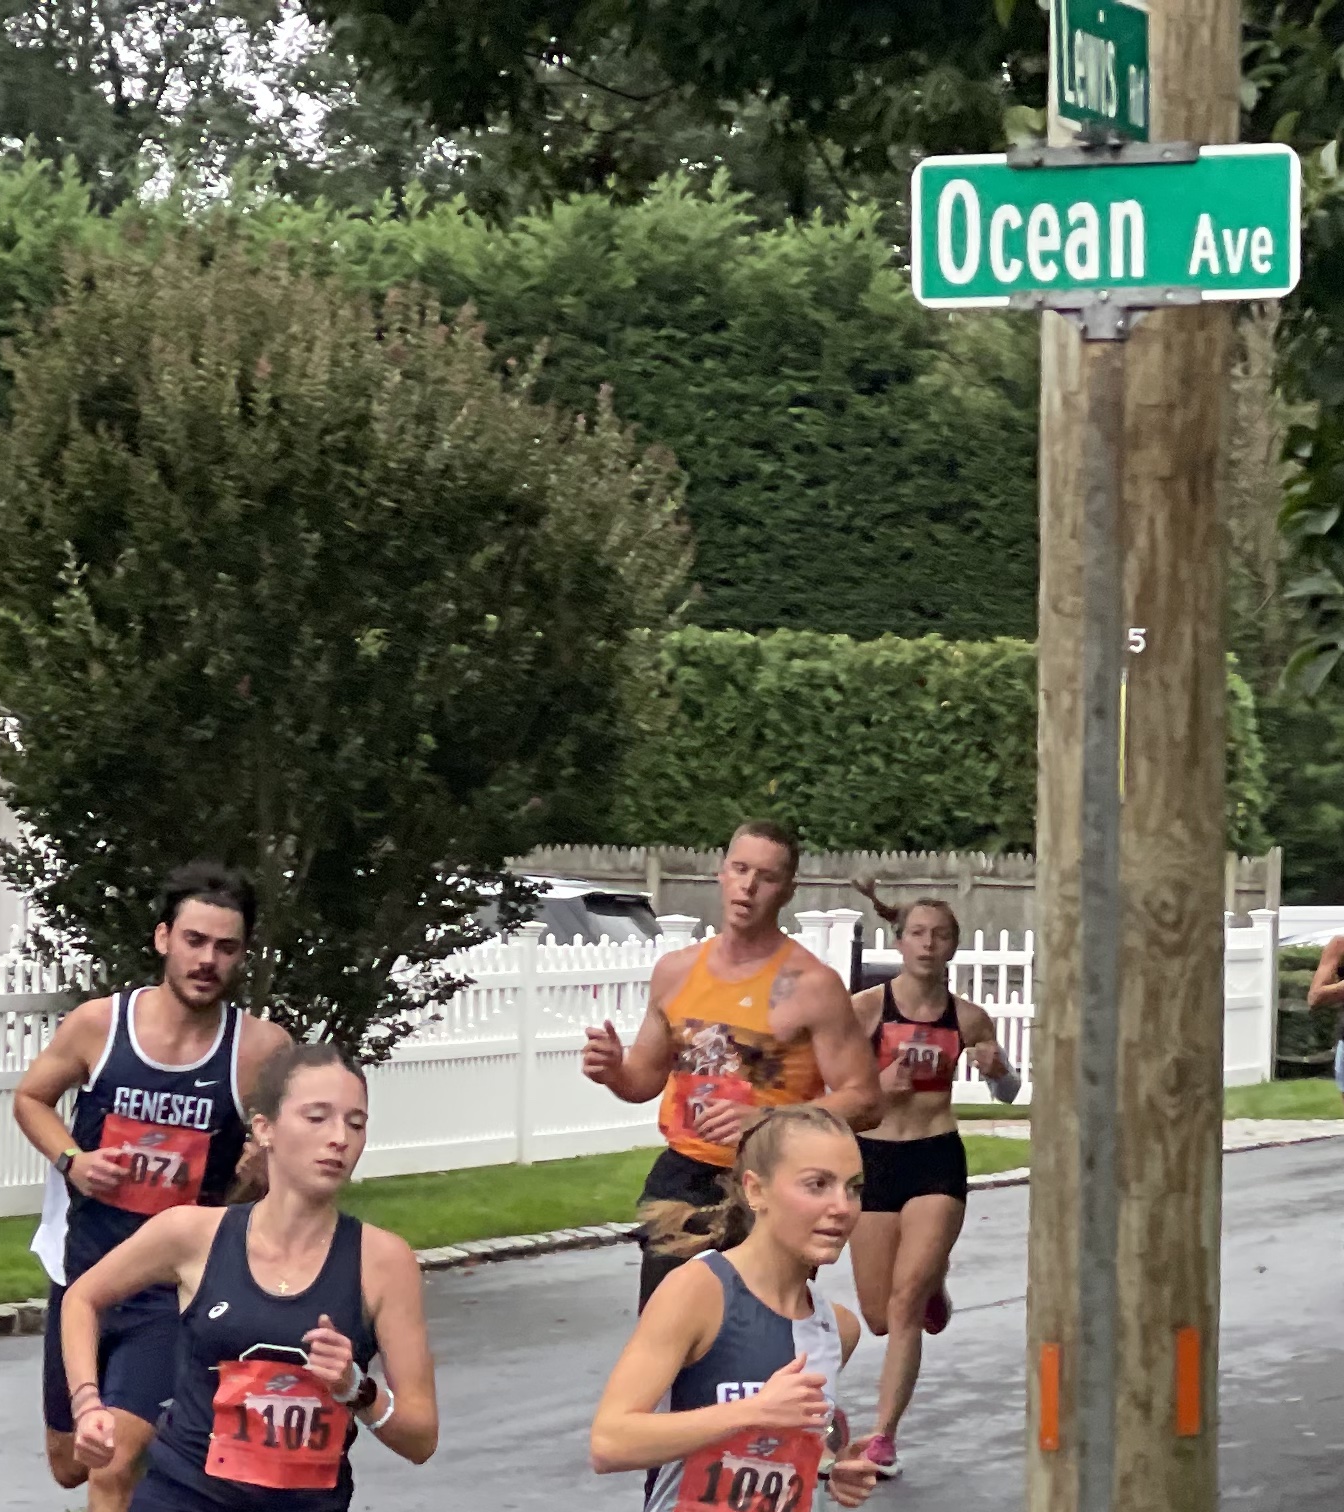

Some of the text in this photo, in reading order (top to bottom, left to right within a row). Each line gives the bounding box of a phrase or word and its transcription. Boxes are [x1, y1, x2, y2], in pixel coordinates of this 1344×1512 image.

[937, 178, 1274, 285] Ocean Ave
[1128, 627, 1146, 654] 5
[113, 1086, 214, 1130] GENESEO
[129, 1151, 189, 1188] 074
[232, 1403, 333, 1450] 1105
